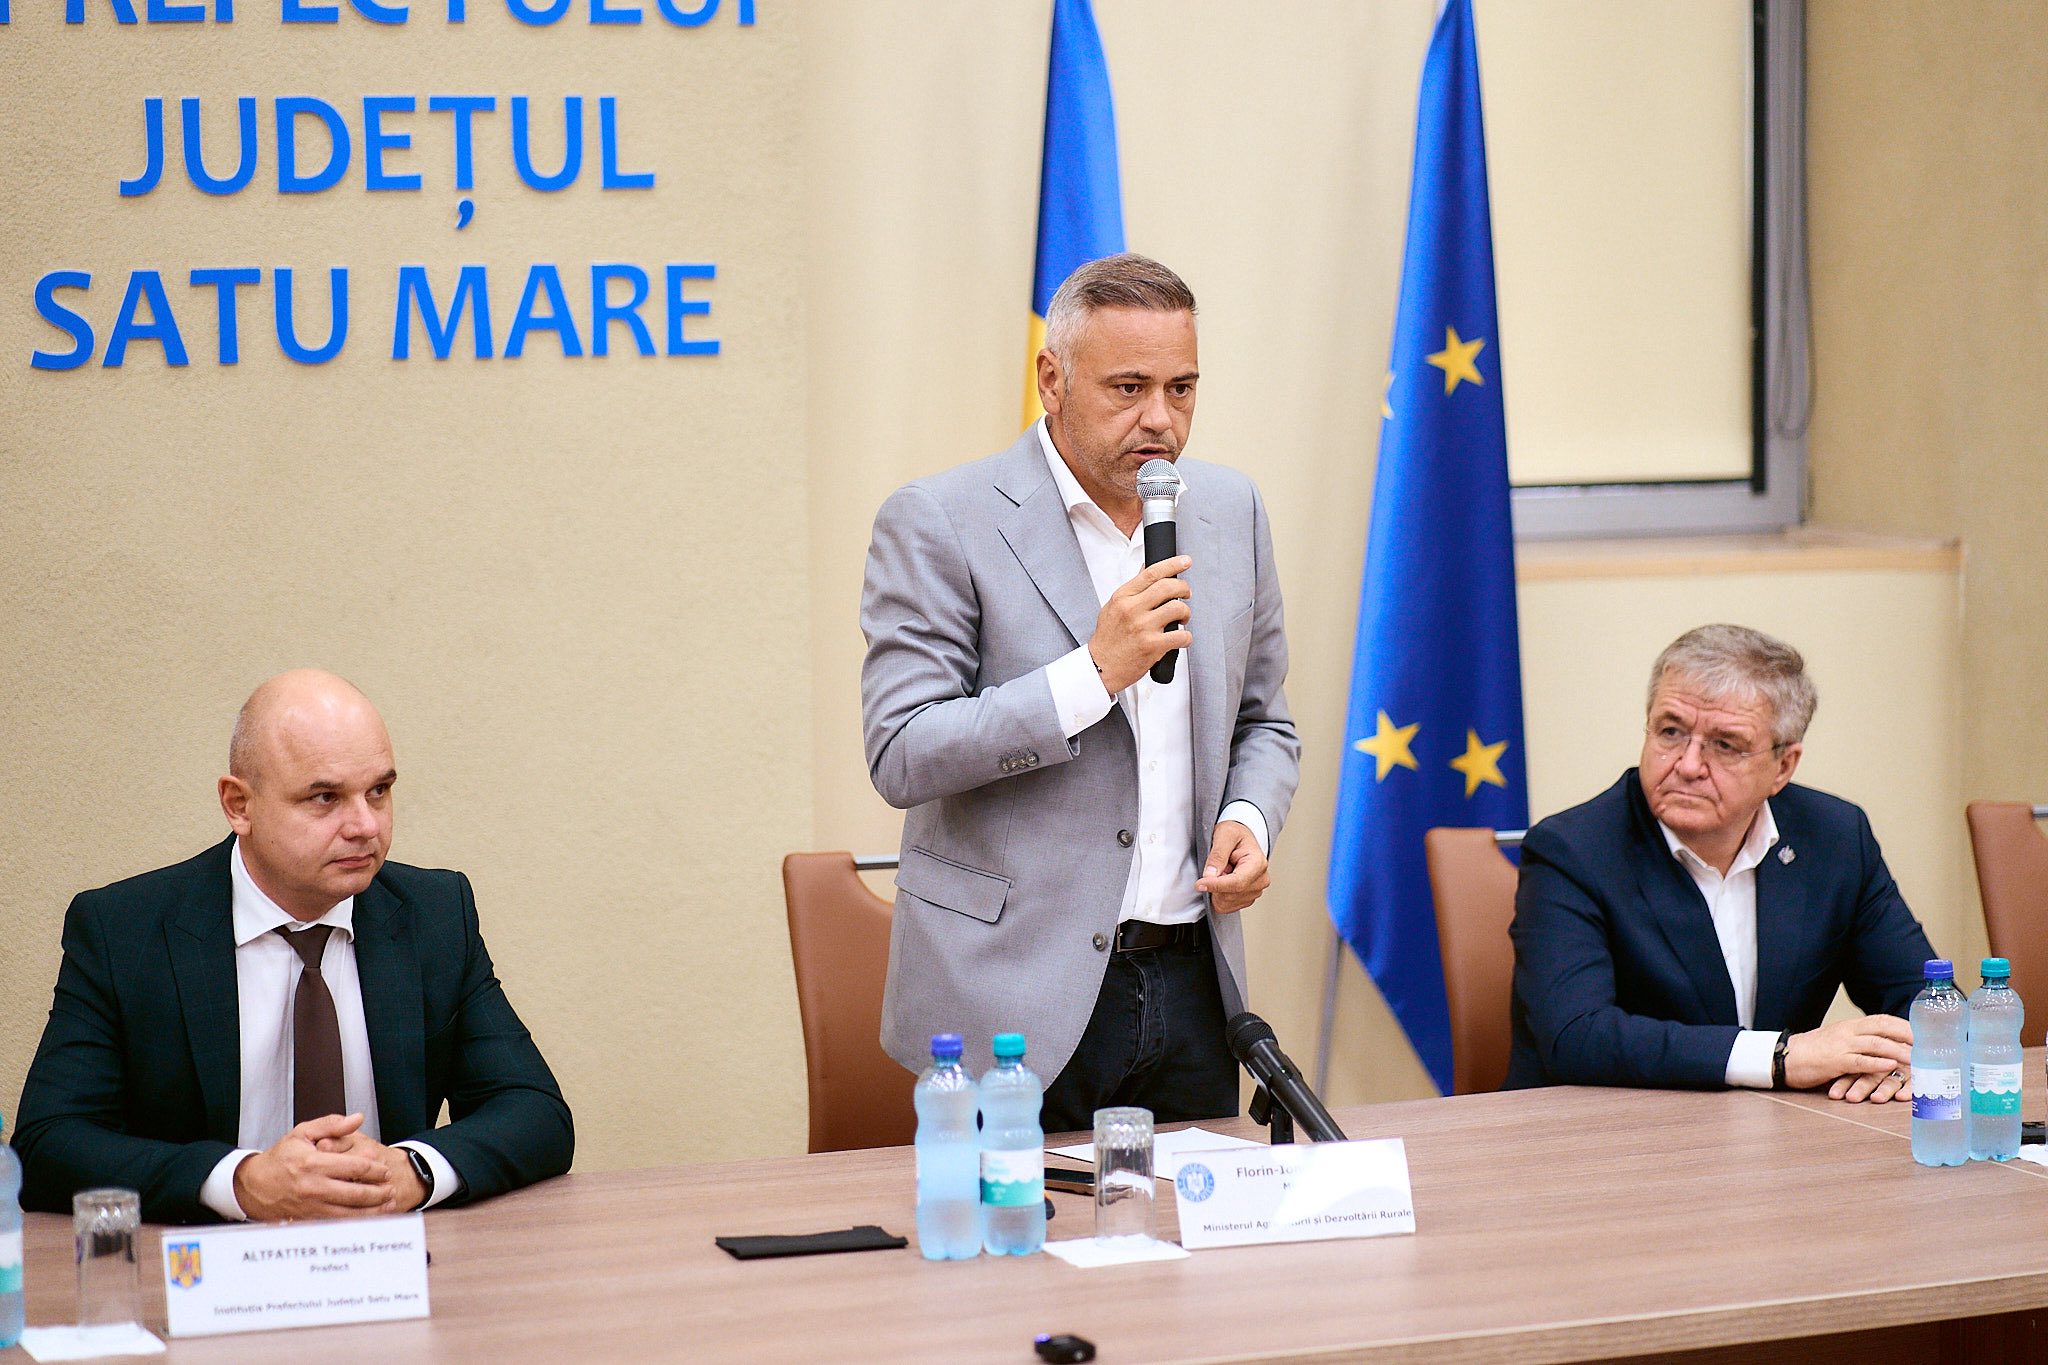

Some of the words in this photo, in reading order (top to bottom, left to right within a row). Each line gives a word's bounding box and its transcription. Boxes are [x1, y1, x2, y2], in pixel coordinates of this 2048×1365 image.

[119, 95, 655, 230] JUDEȚUL
[30, 266, 350, 371] SATU
[391, 264, 721, 361] MARE
[1203, 1221, 1252, 1232] Ministerul
[1380, 1209, 1412, 1219] Rurale
[243, 1246, 317, 1261] ALTFATTER
